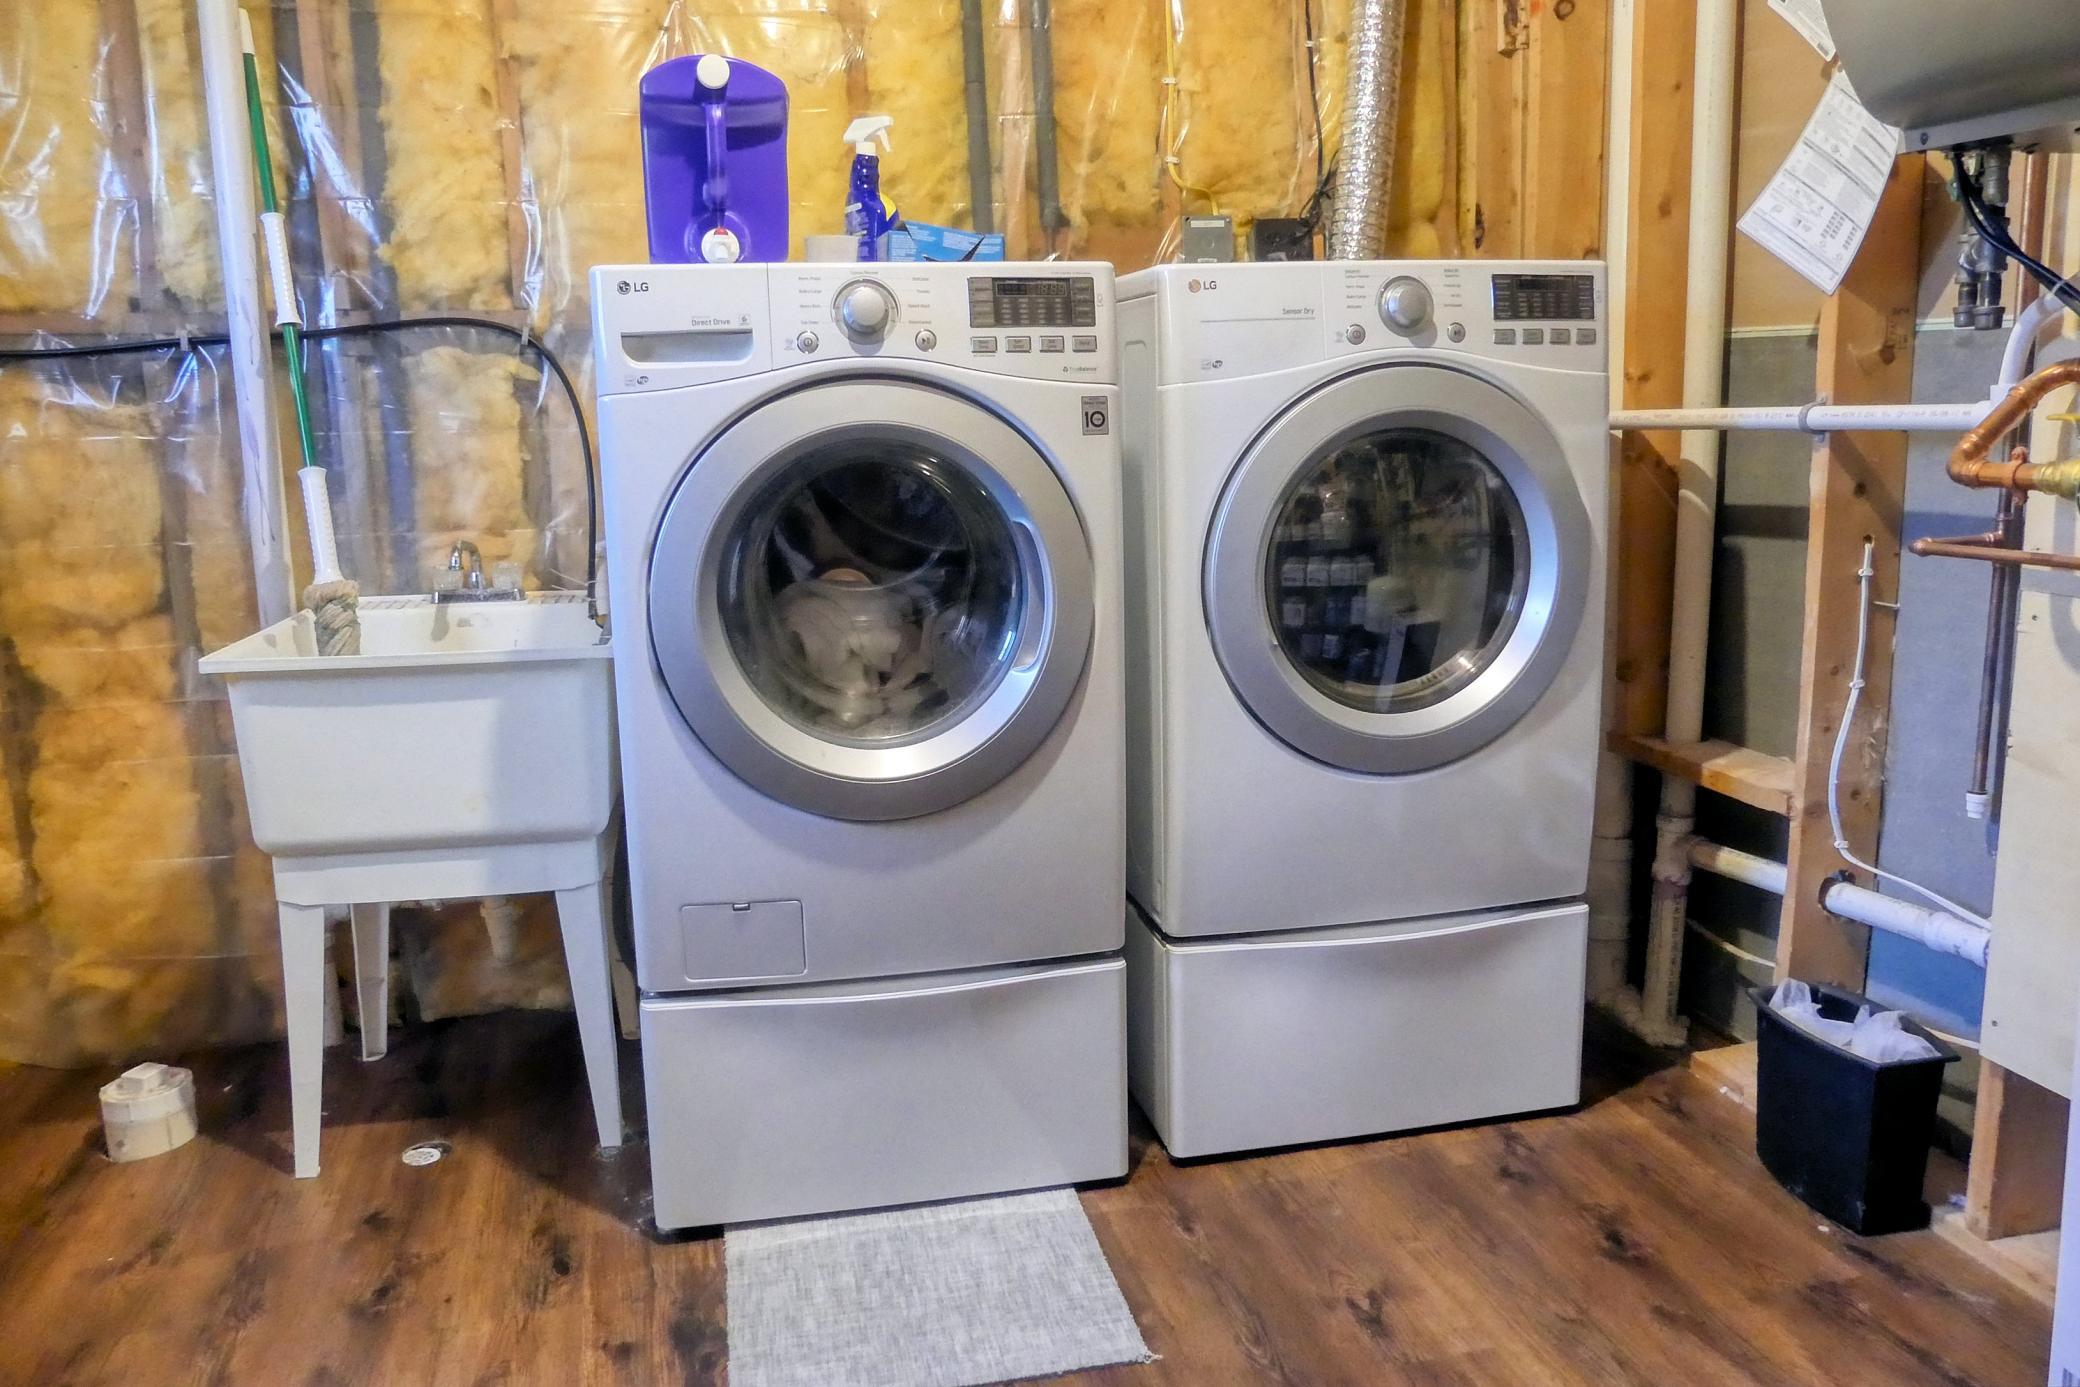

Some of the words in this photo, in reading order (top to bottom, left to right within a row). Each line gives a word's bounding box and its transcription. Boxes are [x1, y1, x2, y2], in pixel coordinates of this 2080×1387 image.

[633, 282, 649, 292] LG
[1203, 280, 1217, 290] LG
[1282, 307, 1302, 315] Sensor
[1303, 307, 1315, 315] Dry
[713, 318, 731, 326] Drive
